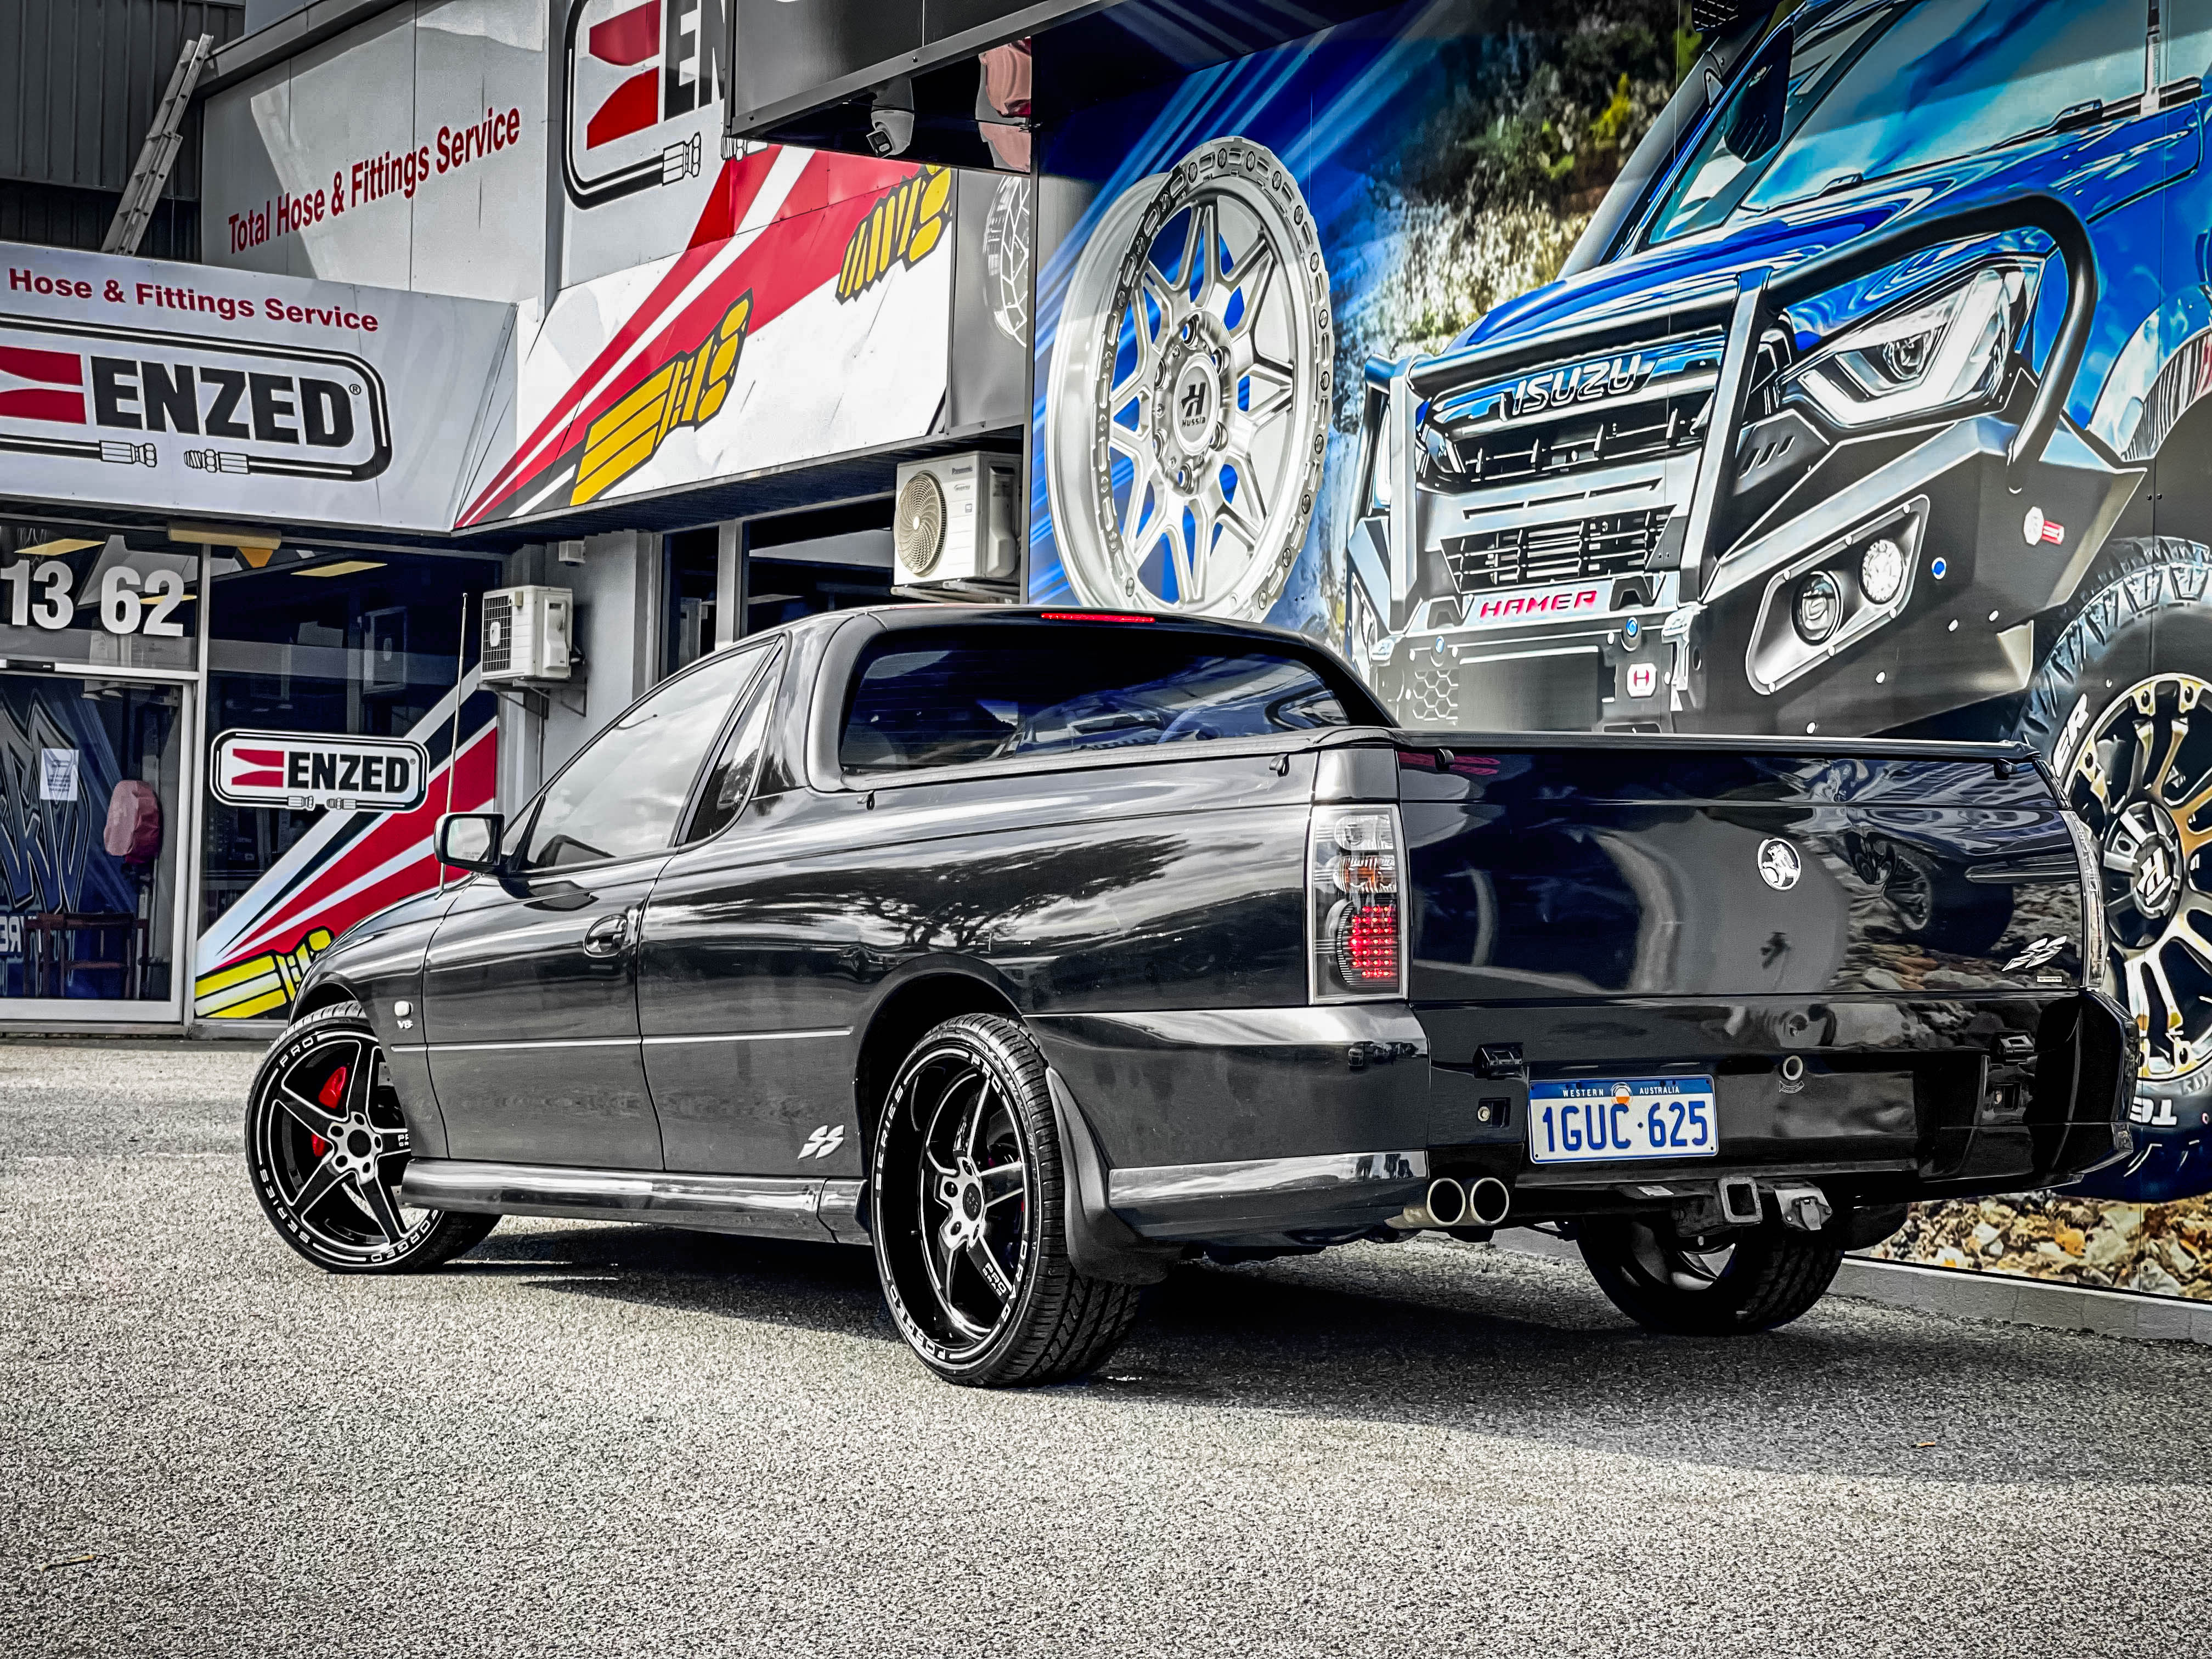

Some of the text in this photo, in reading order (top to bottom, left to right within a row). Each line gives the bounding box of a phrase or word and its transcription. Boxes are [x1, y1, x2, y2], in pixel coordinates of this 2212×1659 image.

[228, 108, 521, 254] Total Hose & Fittings Service
[9, 268, 379, 332] Hose & Fittings Service
[90, 356, 356, 448] ENZED
[1511, 354, 1641, 416] ISUZU
[0, 560, 184, 637] 13 62
[1480, 590, 1598, 618] HAMER
[2051, 693, 2089, 778] ER
[287, 750, 409, 793] ENZED
[279, 1036, 314, 1068] PRO
[971, 1053, 1002, 1094] PRO
[1562, 1086, 1680, 1097] WESTERN AUSTRALIA
[875, 1085, 904, 1190] SERIES
[259, 1169, 311, 1244] SERIES
[985, 1262, 1007, 1294] PRO
[889, 1284, 946, 1360] FORGED
